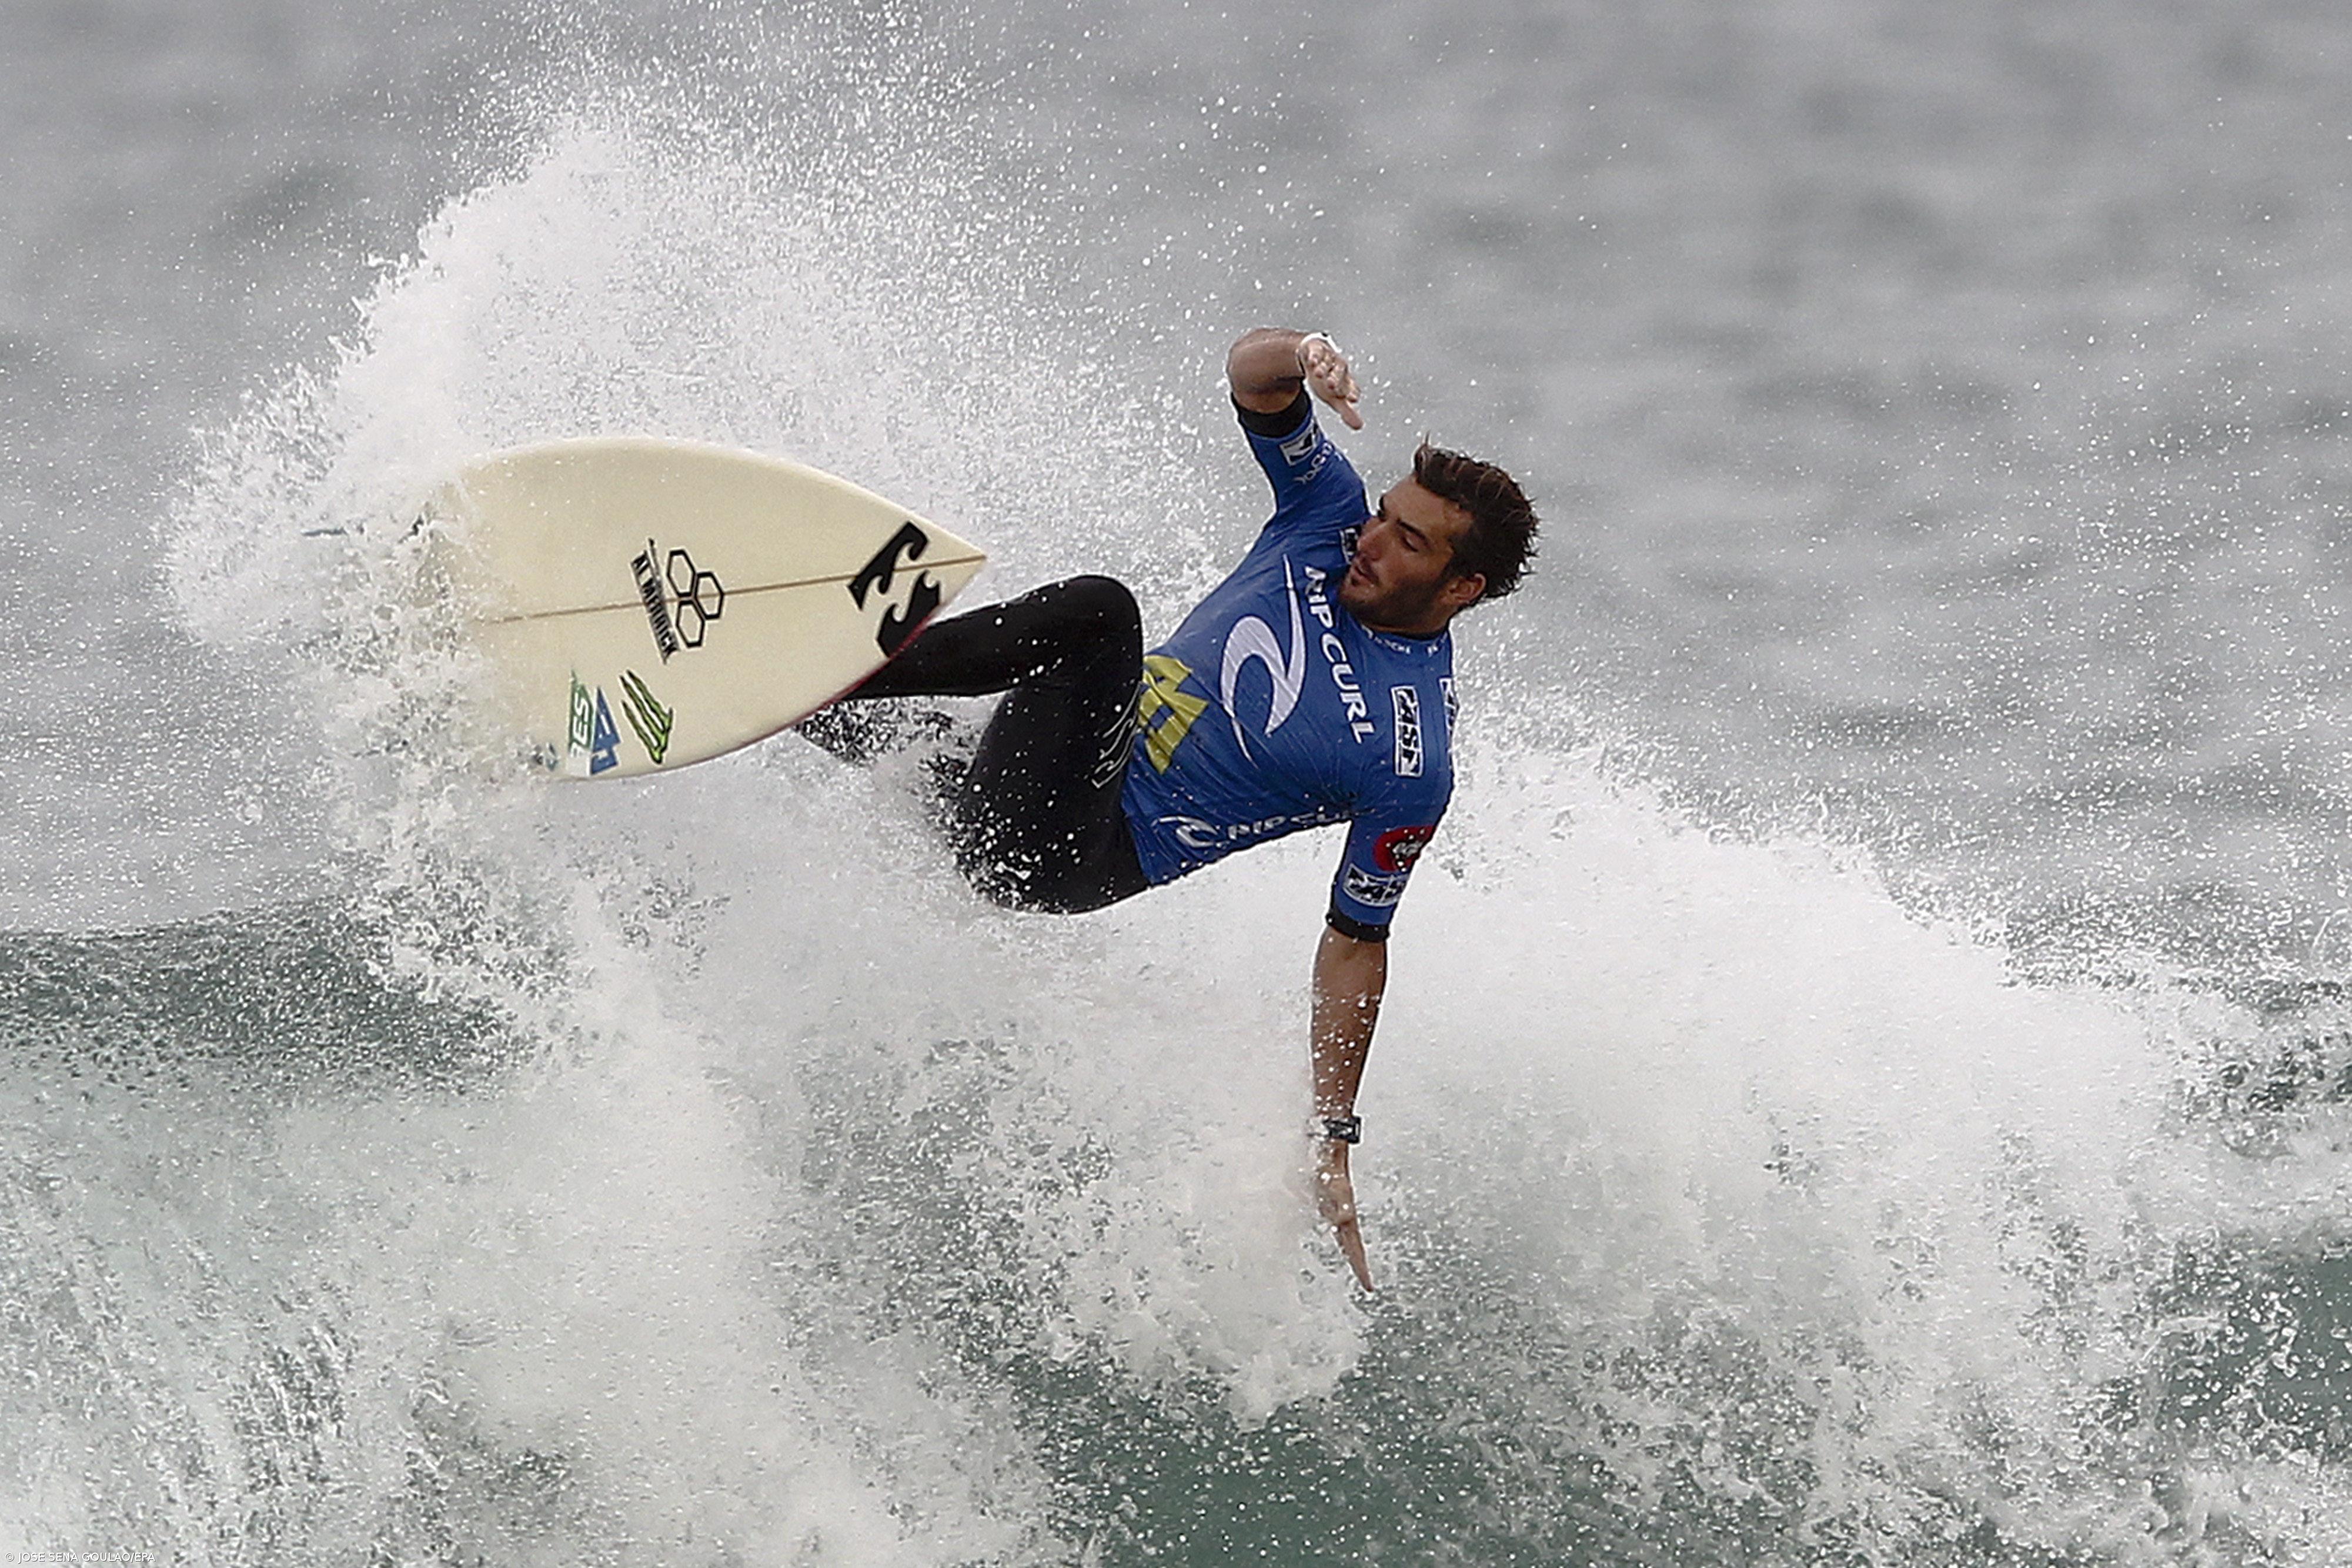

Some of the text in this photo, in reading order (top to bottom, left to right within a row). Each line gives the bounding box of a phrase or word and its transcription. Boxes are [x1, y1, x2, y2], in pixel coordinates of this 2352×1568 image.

[631, 550, 652, 584] AL
[1304, 565, 1375, 744] RIP CURL
